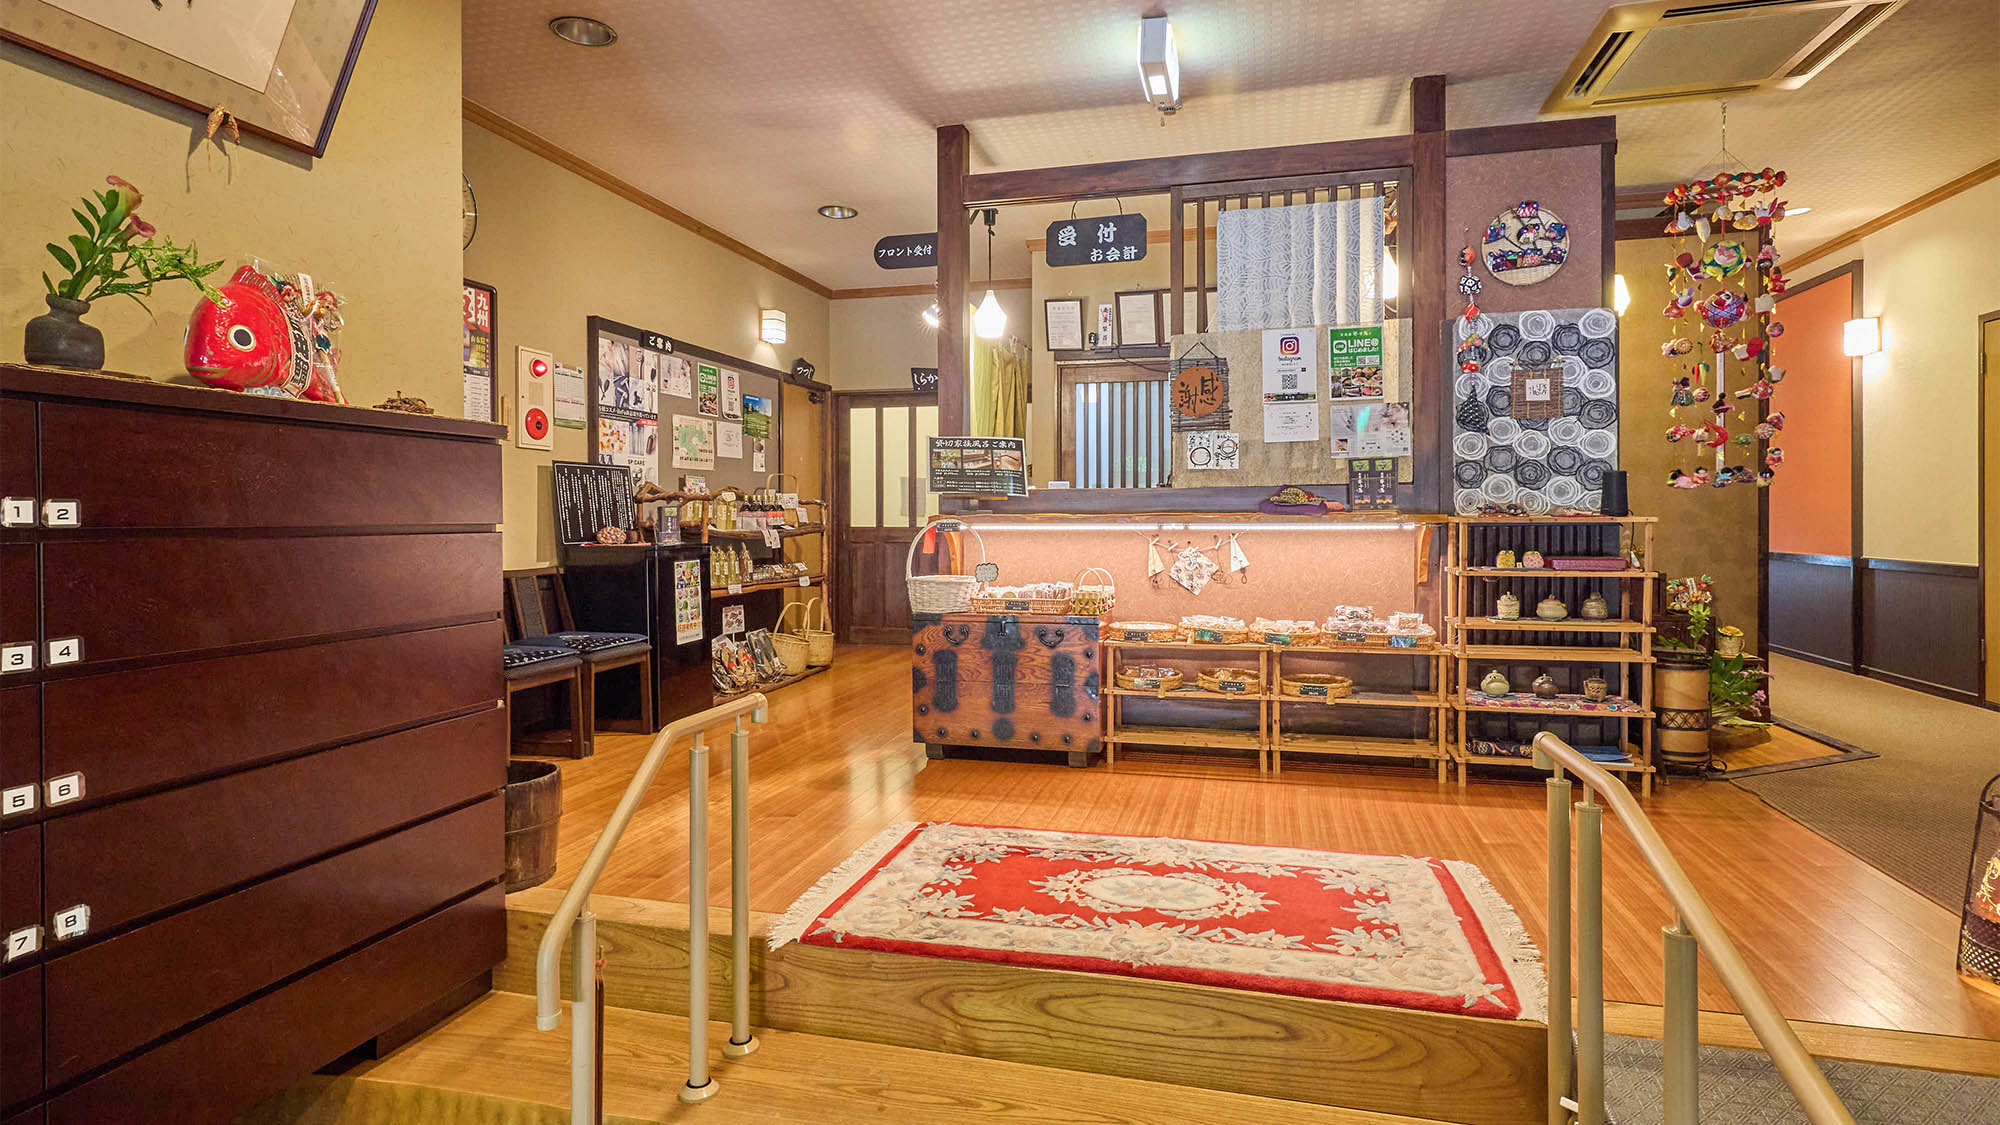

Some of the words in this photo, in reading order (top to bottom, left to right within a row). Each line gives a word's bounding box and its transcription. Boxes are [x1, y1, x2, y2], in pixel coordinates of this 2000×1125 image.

[1057, 221, 1117, 247] 受付
[878, 244, 933, 258] フロント受付
[1090, 246, 1139, 262] お会計
[476, 293, 489, 328] 九州
[648, 335, 672, 352] ご案内
[1347, 338, 1379, 348] LINE@
[796, 366, 813, 380] つつじ
[1178, 371, 1219, 413] 感謝
[13, 506, 20, 518] 1
[57, 508, 69, 520] 2
[59, 645, 71, 657] 4
[11, 653, 24, 666] 3
[58, 783, 71, 797] 6
[12, 795, 26, 808] 5
[65, 914, 77, 928] 8
[15, 936, 28, 951] 7
